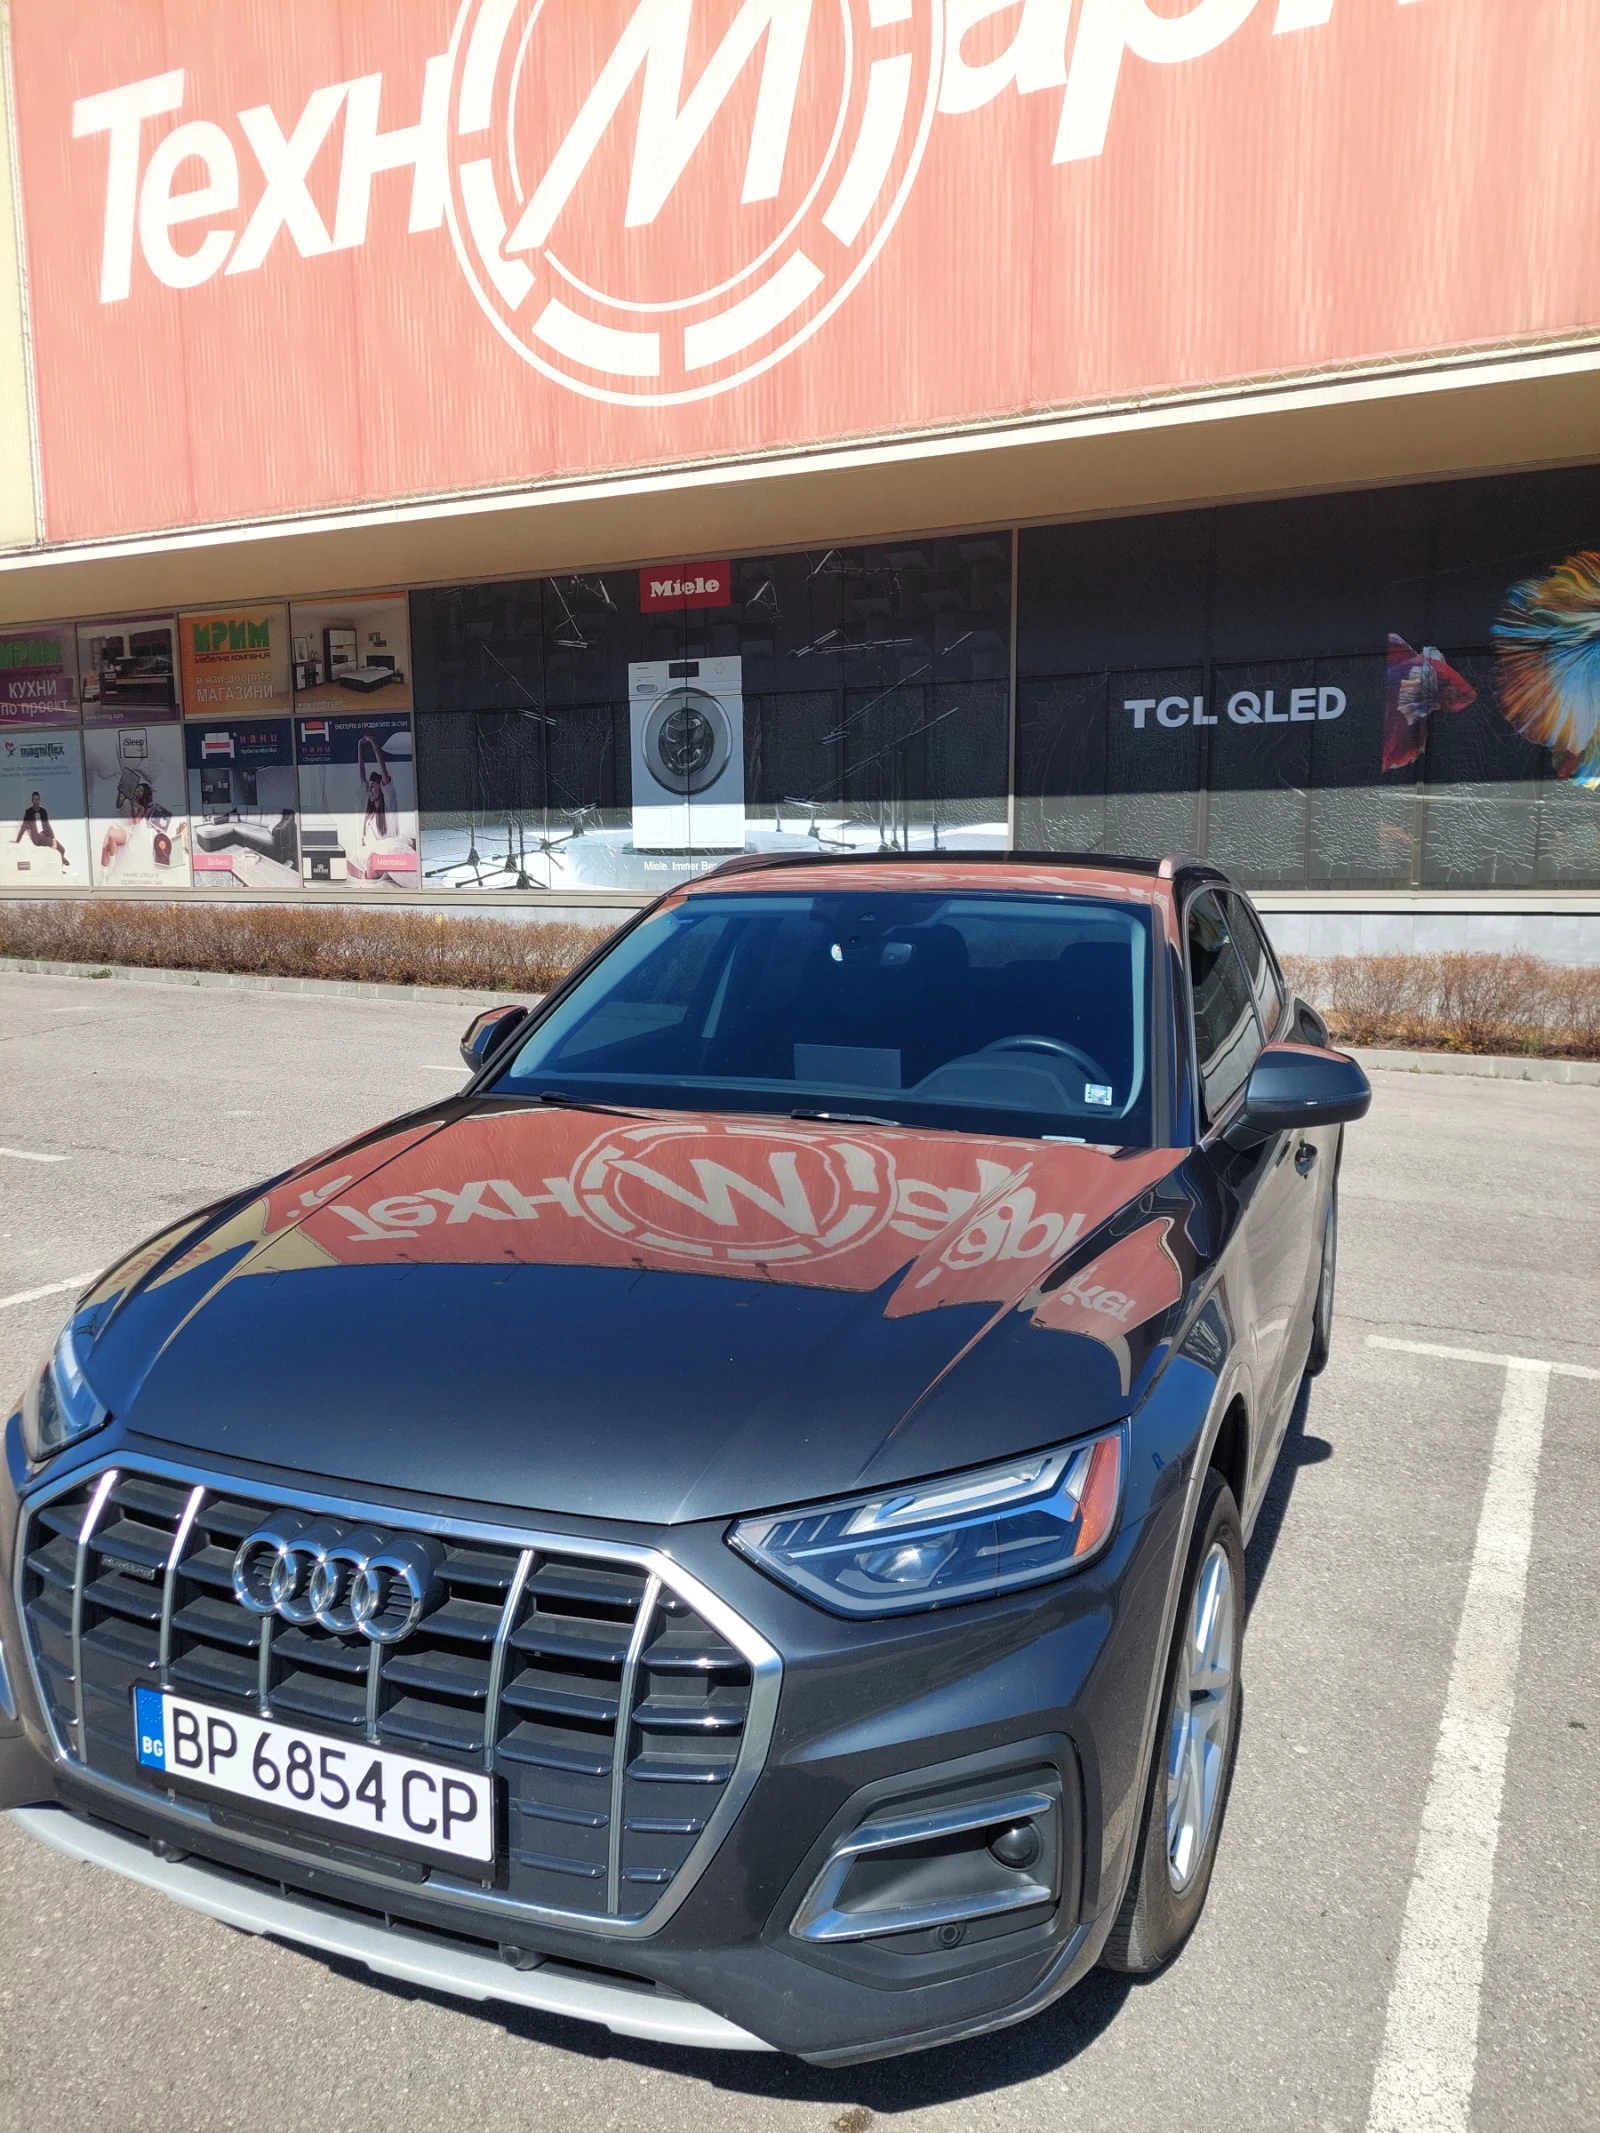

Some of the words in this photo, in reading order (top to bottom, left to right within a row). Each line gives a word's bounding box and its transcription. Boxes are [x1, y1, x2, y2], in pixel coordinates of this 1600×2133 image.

[649, 575, 720, 598] Miele
[194, 618, 270, 652] ИРИМ
[231, 652, 271, 662] компания
[9, 679, 57, 699] КУХНИ
[197, 684, 273, 703] МАГАЗИНИ
[22, 700, 68, 718] проект
[1124, 696, 1218, 729] TCL
[1227, 686, 1347, 724] QLED
[20, 743, 65, 758] magniflex
[207, 857, 230, 866] Дивани
[376, 857, 408, 867] Матраци
[644, 860, 670, 871] Miele.
[672, 861, 699, 871] Immer
[142, 1735, 164, 1757] BG
[253, 1731, 387, 1822] 6854
